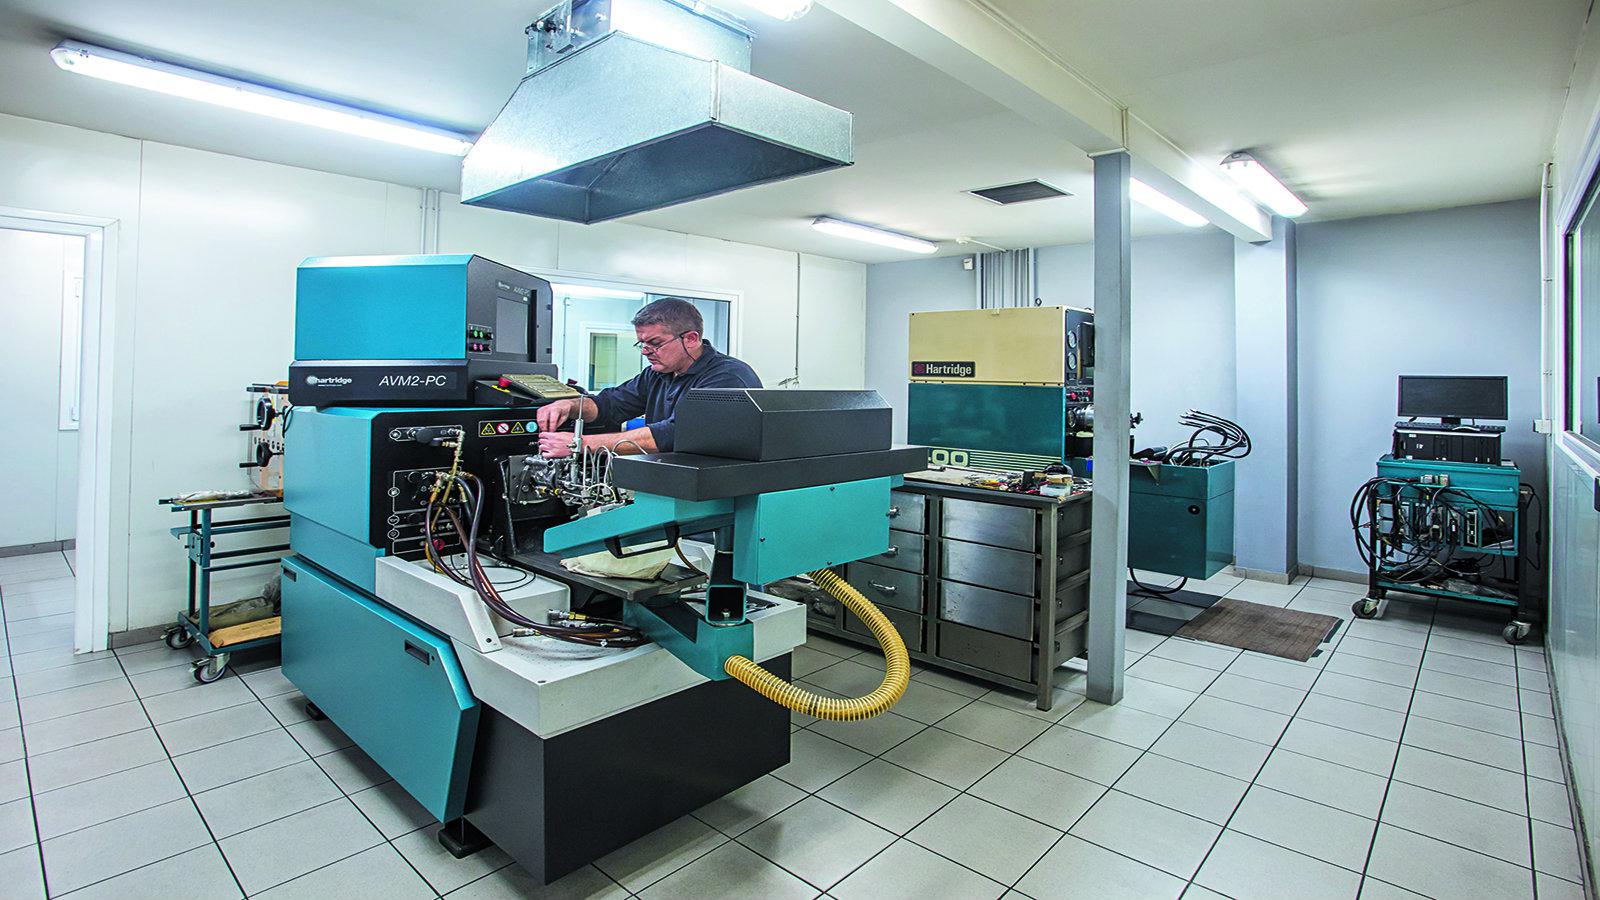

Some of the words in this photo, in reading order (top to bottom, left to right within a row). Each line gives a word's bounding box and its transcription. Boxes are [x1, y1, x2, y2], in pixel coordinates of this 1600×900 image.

[926, 363, 972, 377] Hartridge
[378, 375, 447, 386] AVM2-PC
[928, 449, 968, 466] 00
